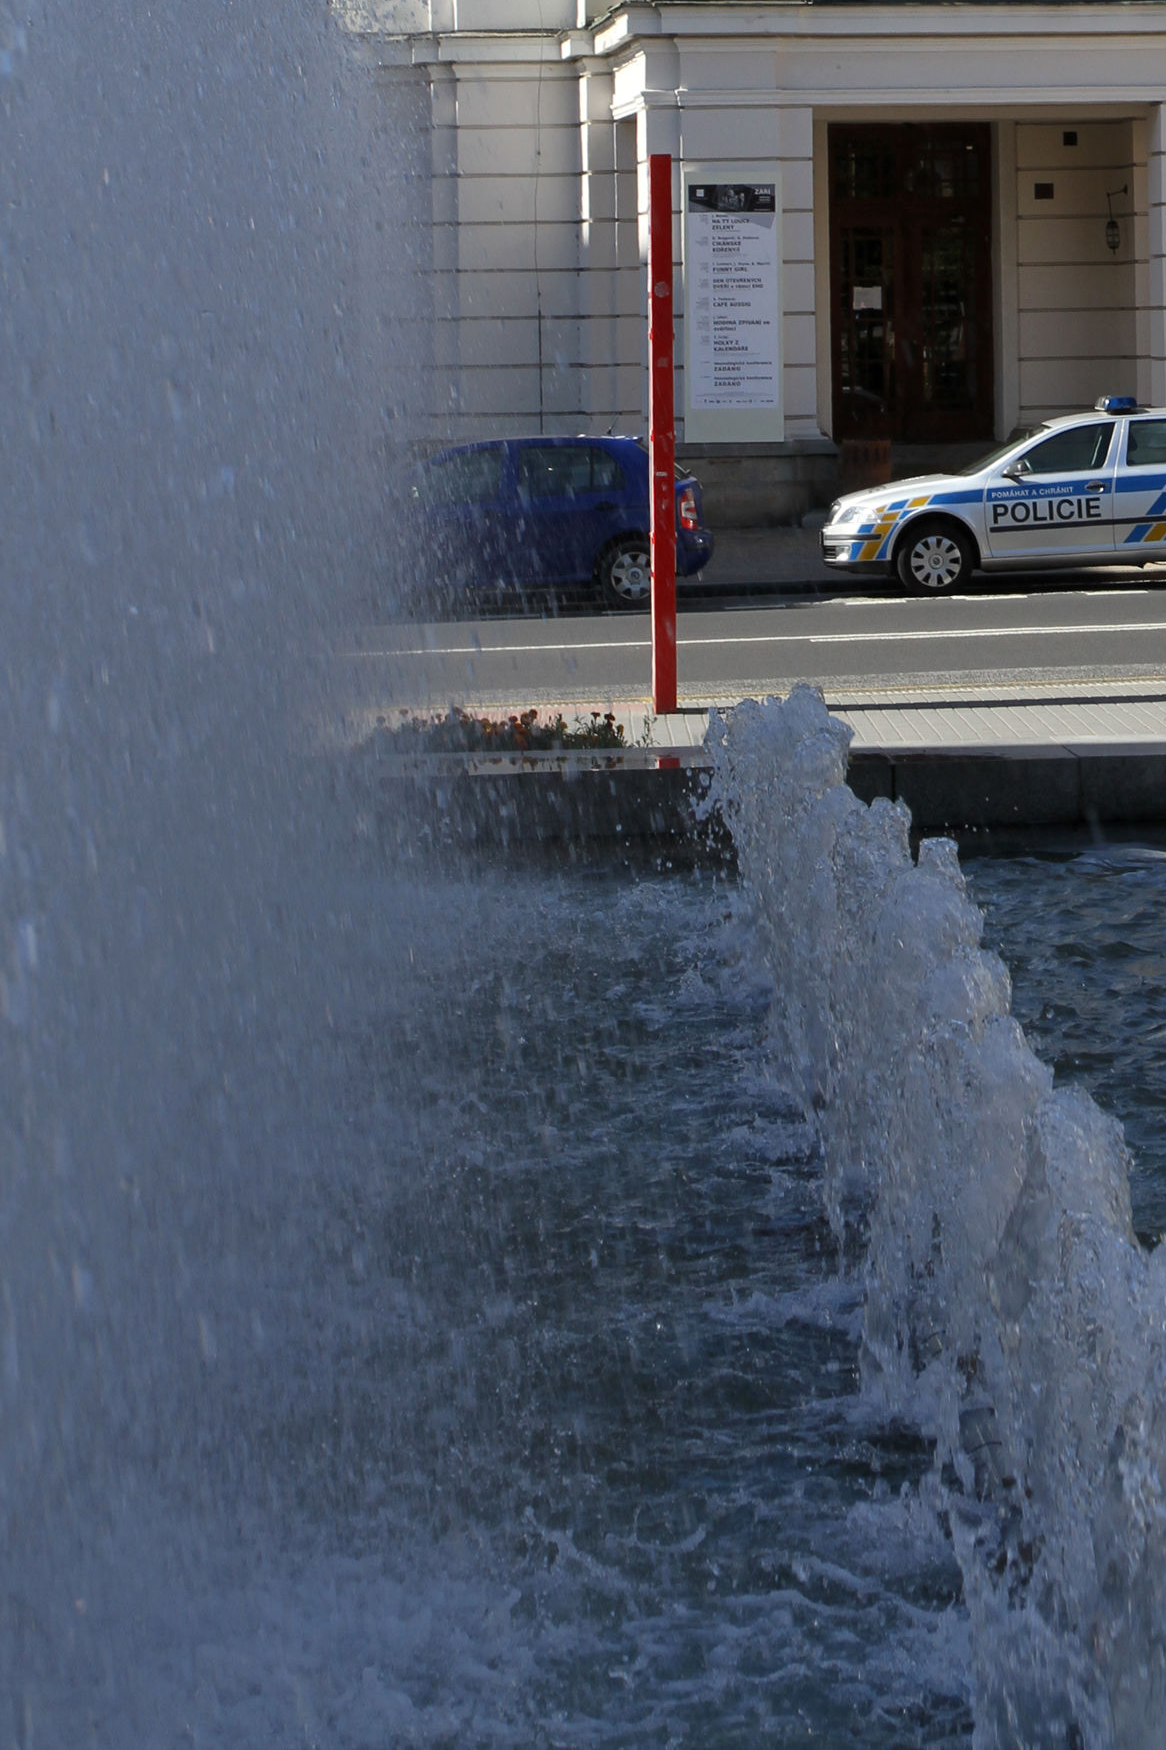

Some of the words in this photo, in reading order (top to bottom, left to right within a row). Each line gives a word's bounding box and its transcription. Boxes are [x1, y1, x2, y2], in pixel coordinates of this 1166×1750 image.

[991, 488, 1029, 499] POMÁHAT
[1039, 486, 1074, 496] CHRÁNIT
[992, 497, 1102, 525] POLICIE
